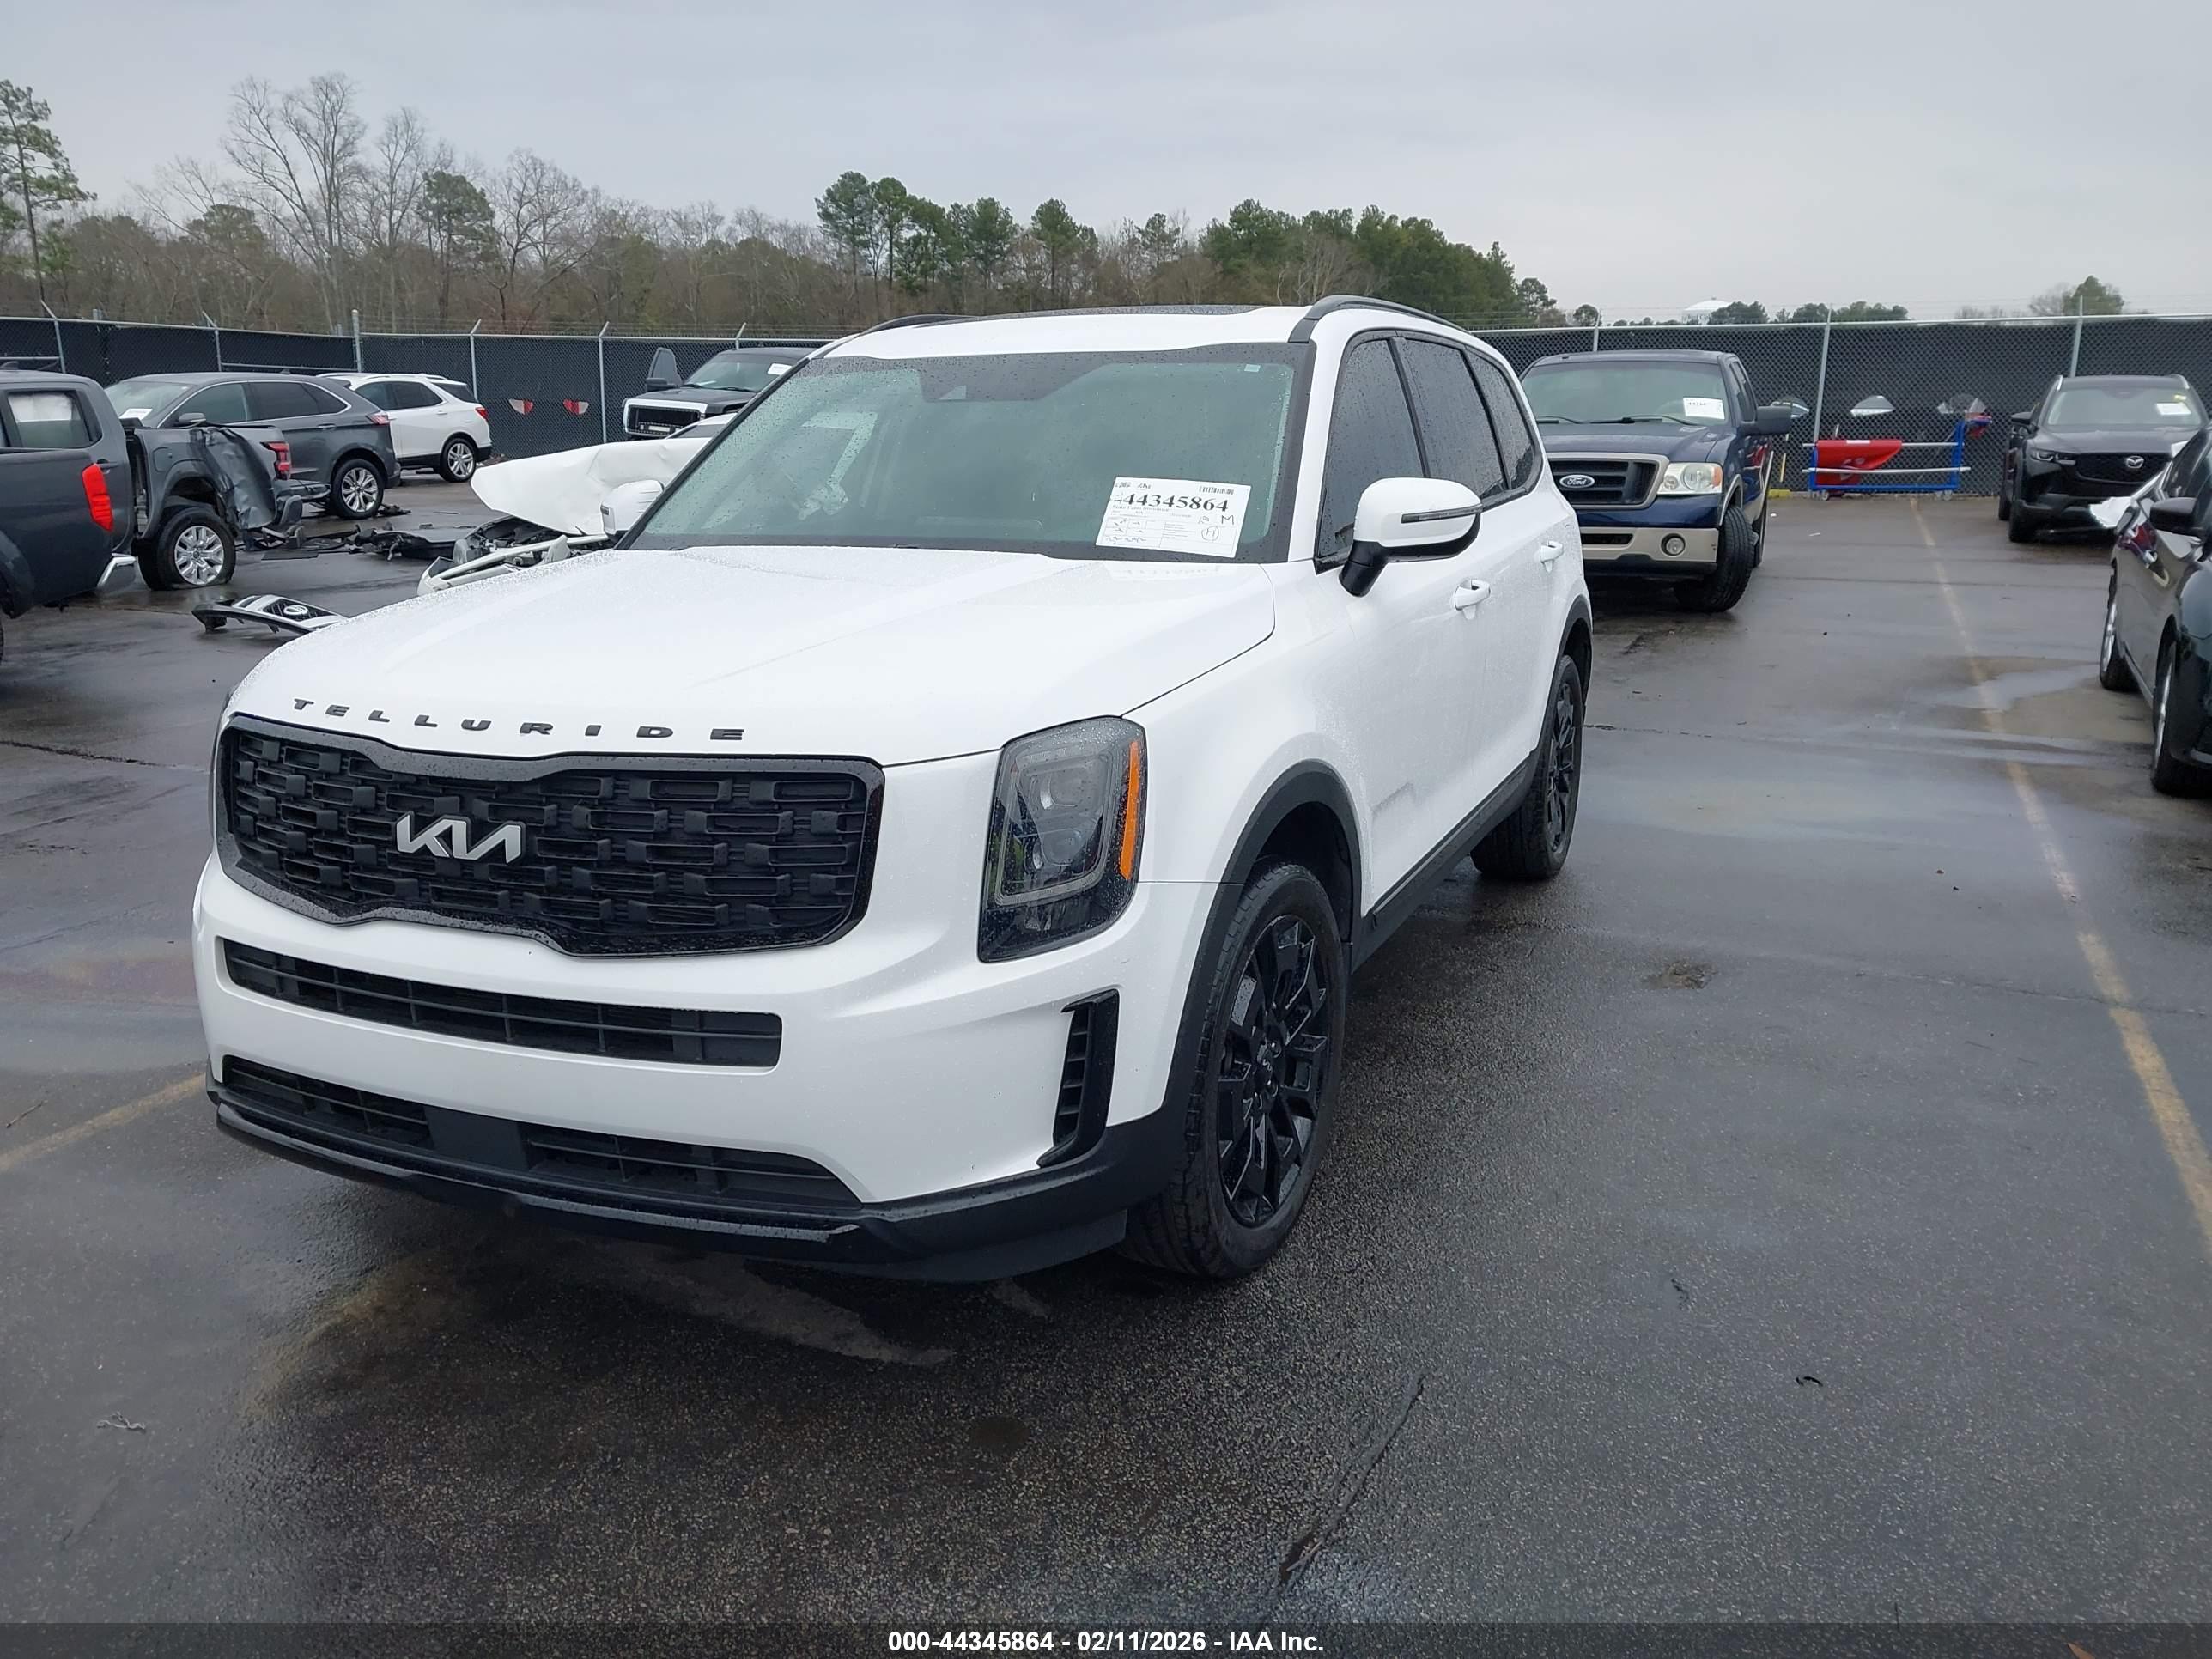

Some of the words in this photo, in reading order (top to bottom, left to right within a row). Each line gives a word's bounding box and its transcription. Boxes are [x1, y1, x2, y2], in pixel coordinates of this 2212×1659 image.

[1221, 514, 1234, 526] M
[293, 698, 745, 741] TELLURIDE
[396, 813, 522, 865] KIA
